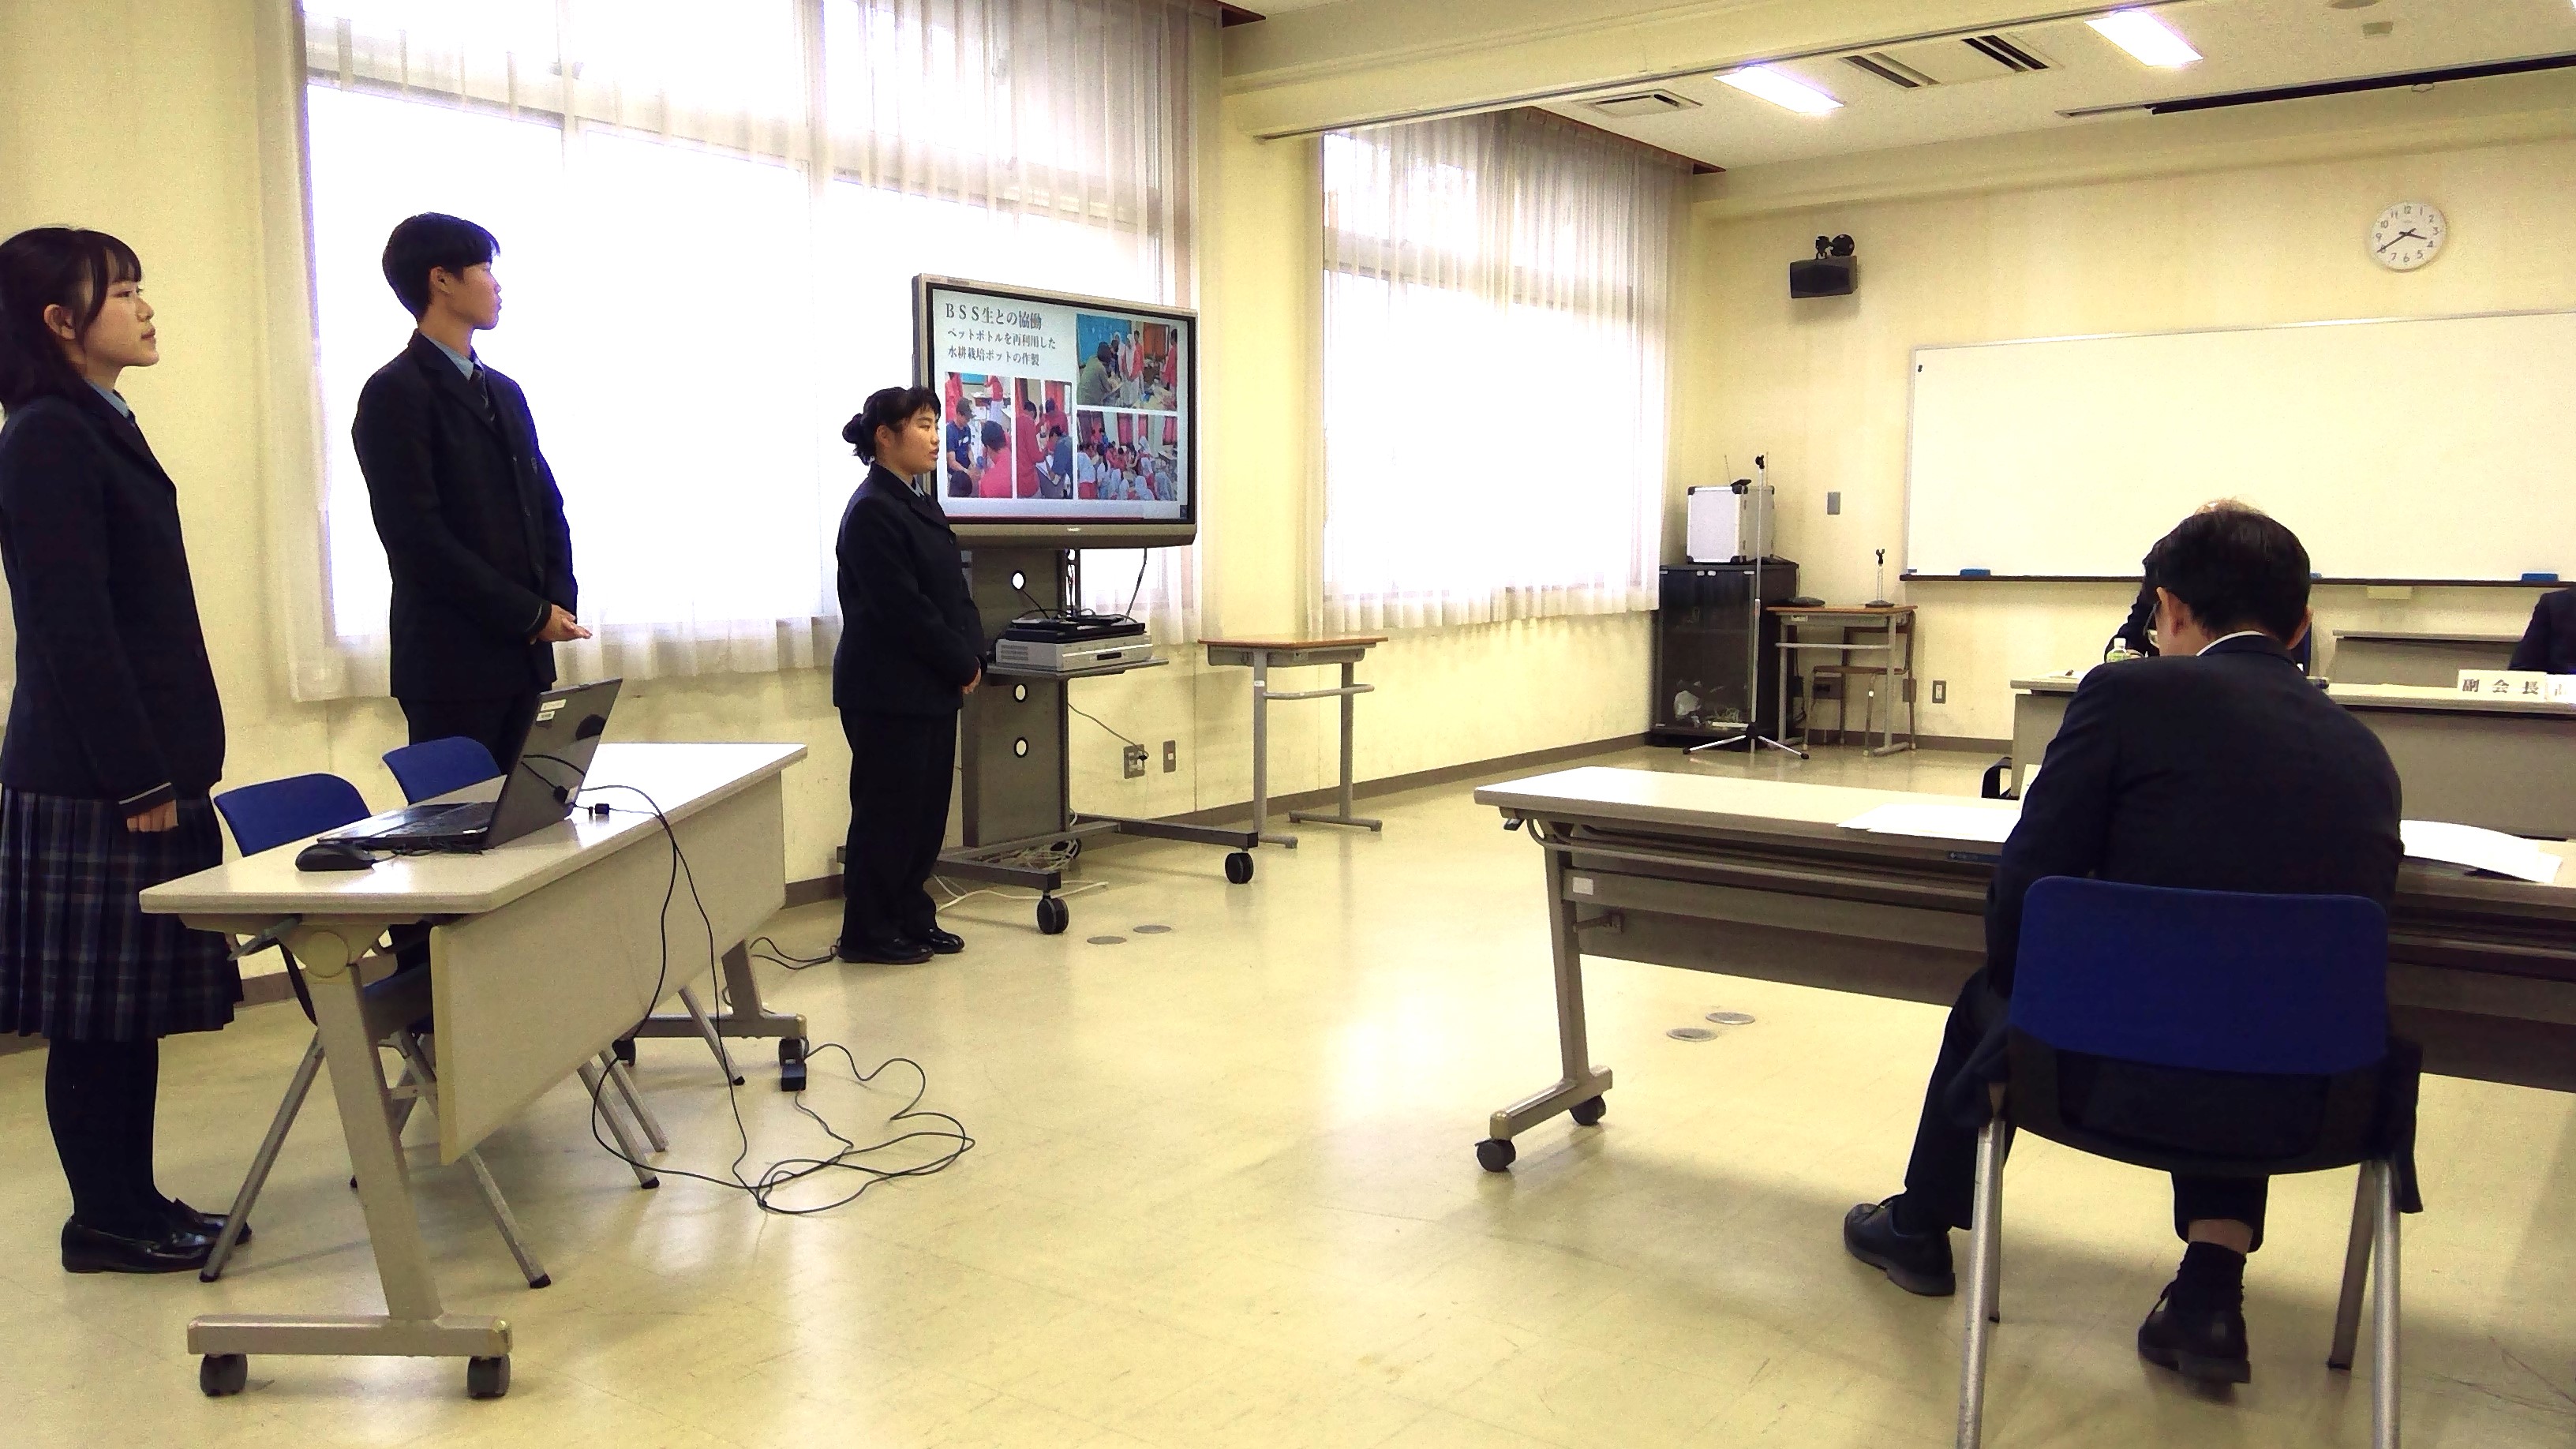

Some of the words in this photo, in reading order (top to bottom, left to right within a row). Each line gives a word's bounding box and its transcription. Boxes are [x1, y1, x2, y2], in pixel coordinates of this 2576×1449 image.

[2420, 207, 2424, 215] 1
[2433, 227, 2439, 235] 3
[2376, 233, 2382, 242] 9
[2403, 253, 2410, 263] 6
[2417, 250, 2424, 259] 5
[2462, 679, 2539, 695] 副会長
